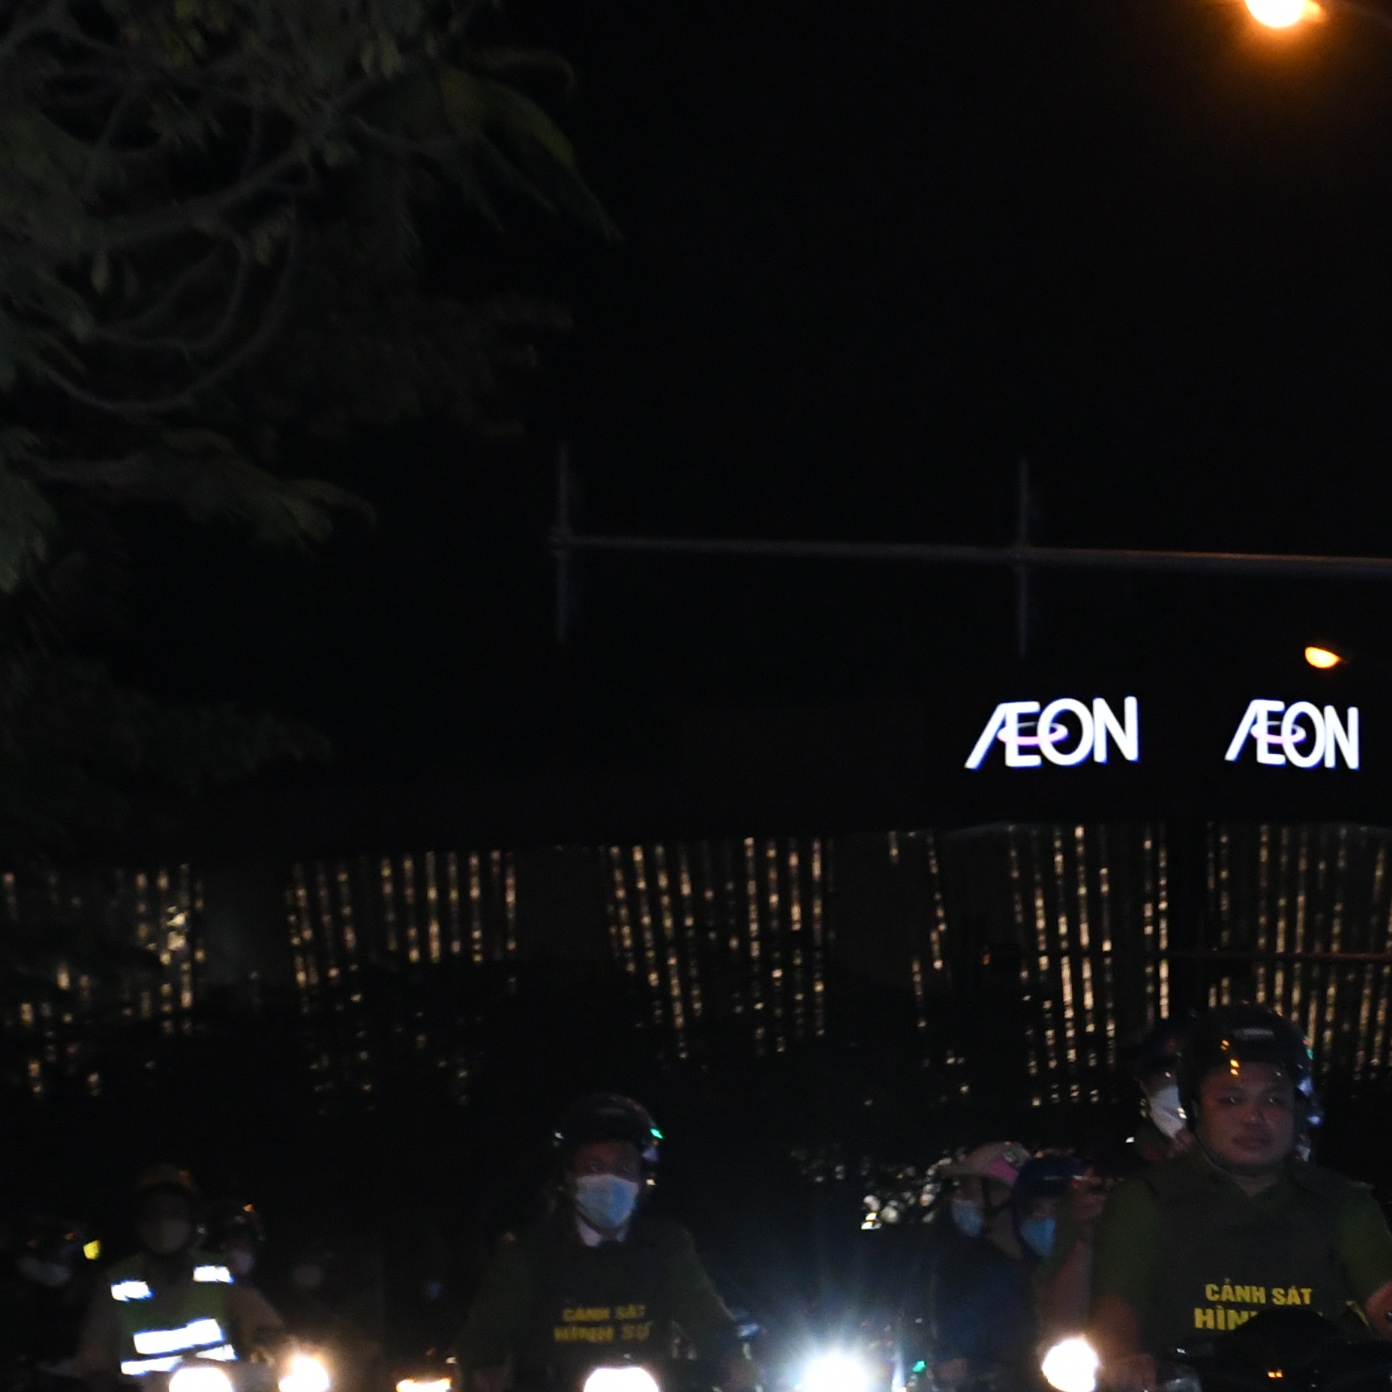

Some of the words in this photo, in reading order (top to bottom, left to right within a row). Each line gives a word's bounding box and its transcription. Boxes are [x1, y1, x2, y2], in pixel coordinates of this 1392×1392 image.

[1205, 1278, 1267, 1304] CẢNH
[1272, 1285, 1313, 1306] SÁT
[1194, 1305, 1260, 1331] HÌN
